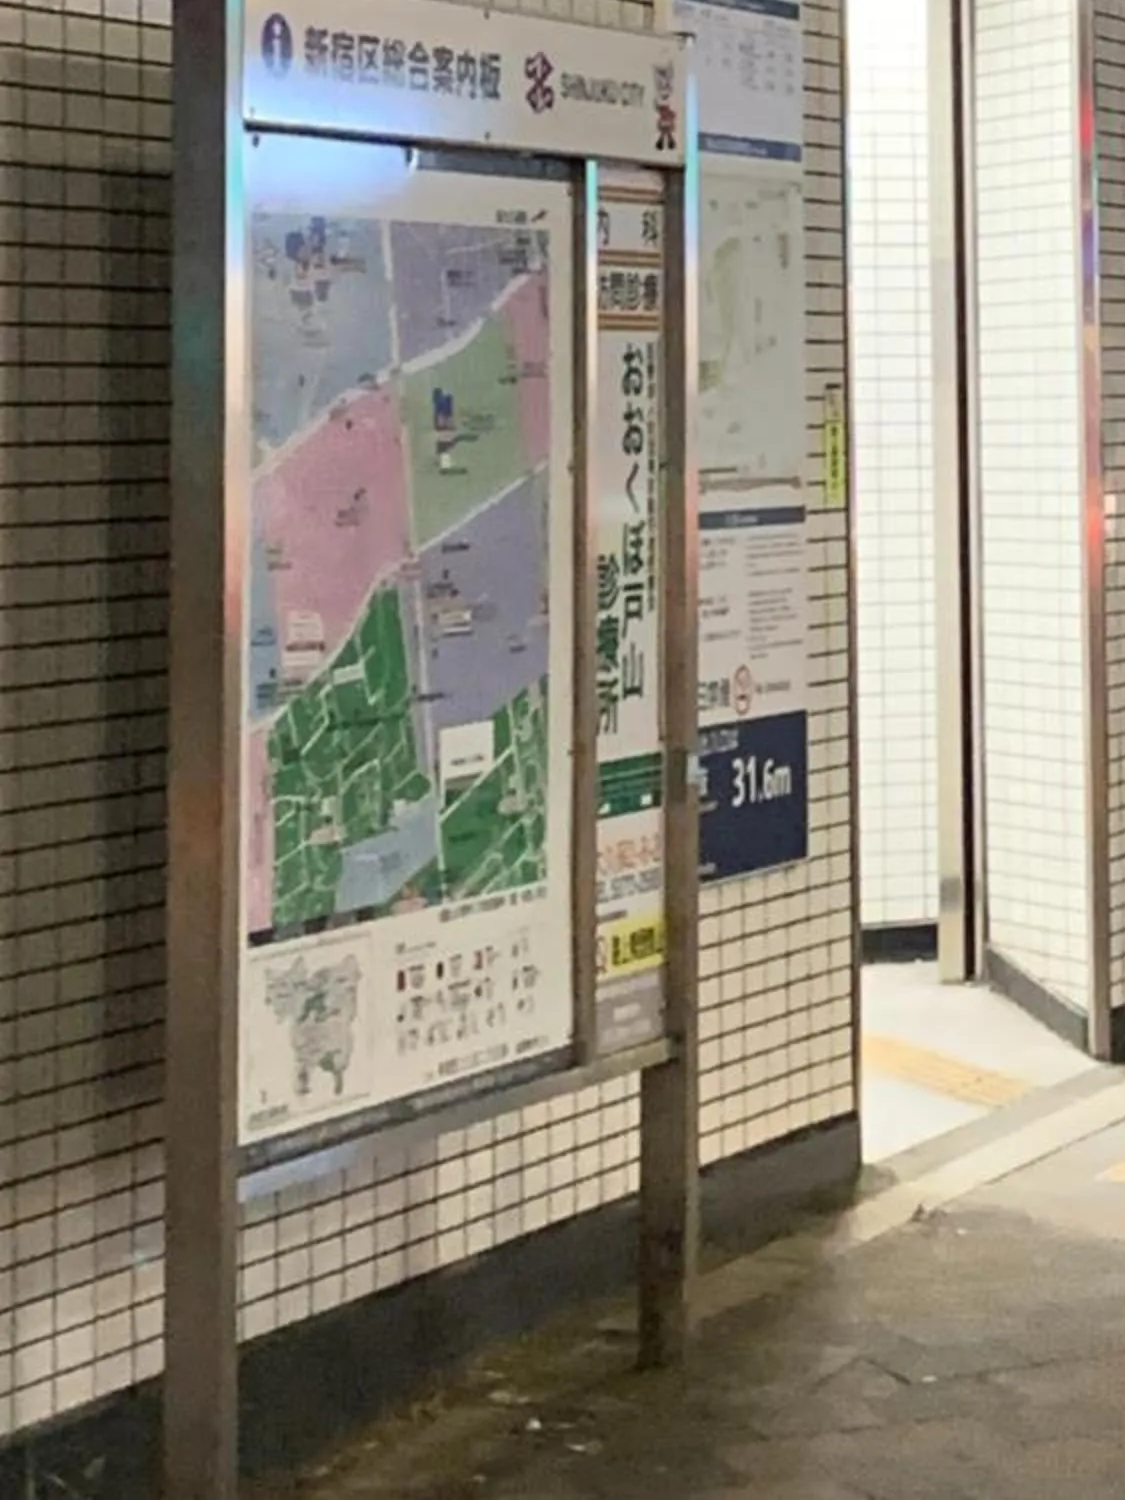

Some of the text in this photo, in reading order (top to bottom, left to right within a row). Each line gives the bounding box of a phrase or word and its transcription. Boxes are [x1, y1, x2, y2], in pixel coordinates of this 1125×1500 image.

[303, 25, 502, 100] 新宿区総合案内板
[731, 755, 793, 808] 31.6m
